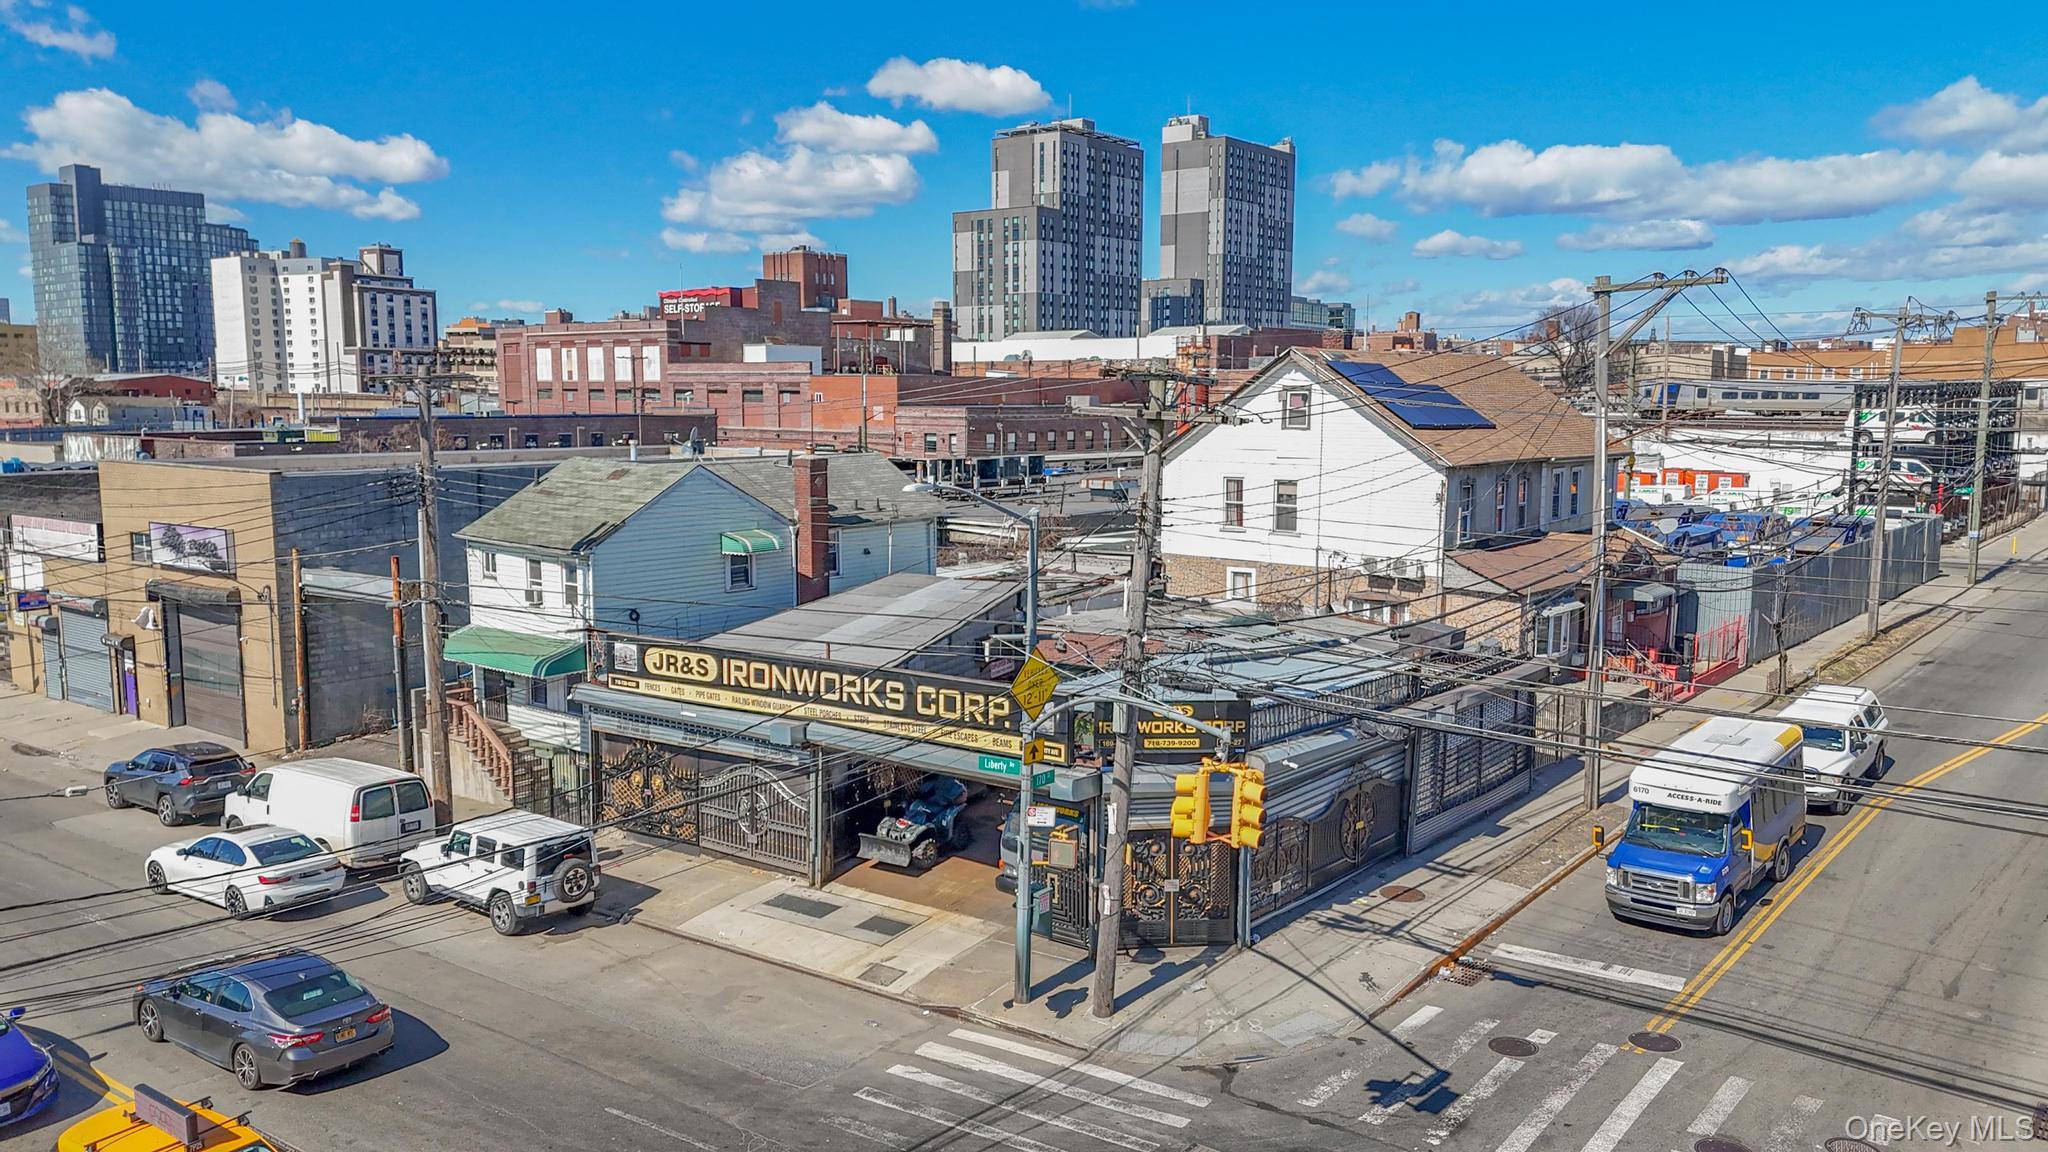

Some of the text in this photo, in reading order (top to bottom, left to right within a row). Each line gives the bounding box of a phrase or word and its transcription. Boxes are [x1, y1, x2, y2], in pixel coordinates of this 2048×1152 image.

[652, 652, 1011, 730] JR&S IRONWORKS CORP.
[644, 682, 661, 692] FENCES
[670, 686, 685, 696] GATES
[695, 688, 706, 699] PIPE
[706, 690, 721, 701] GATES
[731, 695, 751, 706] RAILING
[751, 699, 772, 710] WINDOW
[803, 707, 819, 717] STEEL
[819, 709, 842, 720] PORCHES
[911, 723, 928, 734] STEEL
[953, 731, 979, 744] ESCAPES
[992, 737, 1013, 749] BEAMS
[1146, 739, 1197, 747] 718-739-9200
[984, 758, 1007, 773] Liberty
[1633, 786, 1650, 795] 6170
